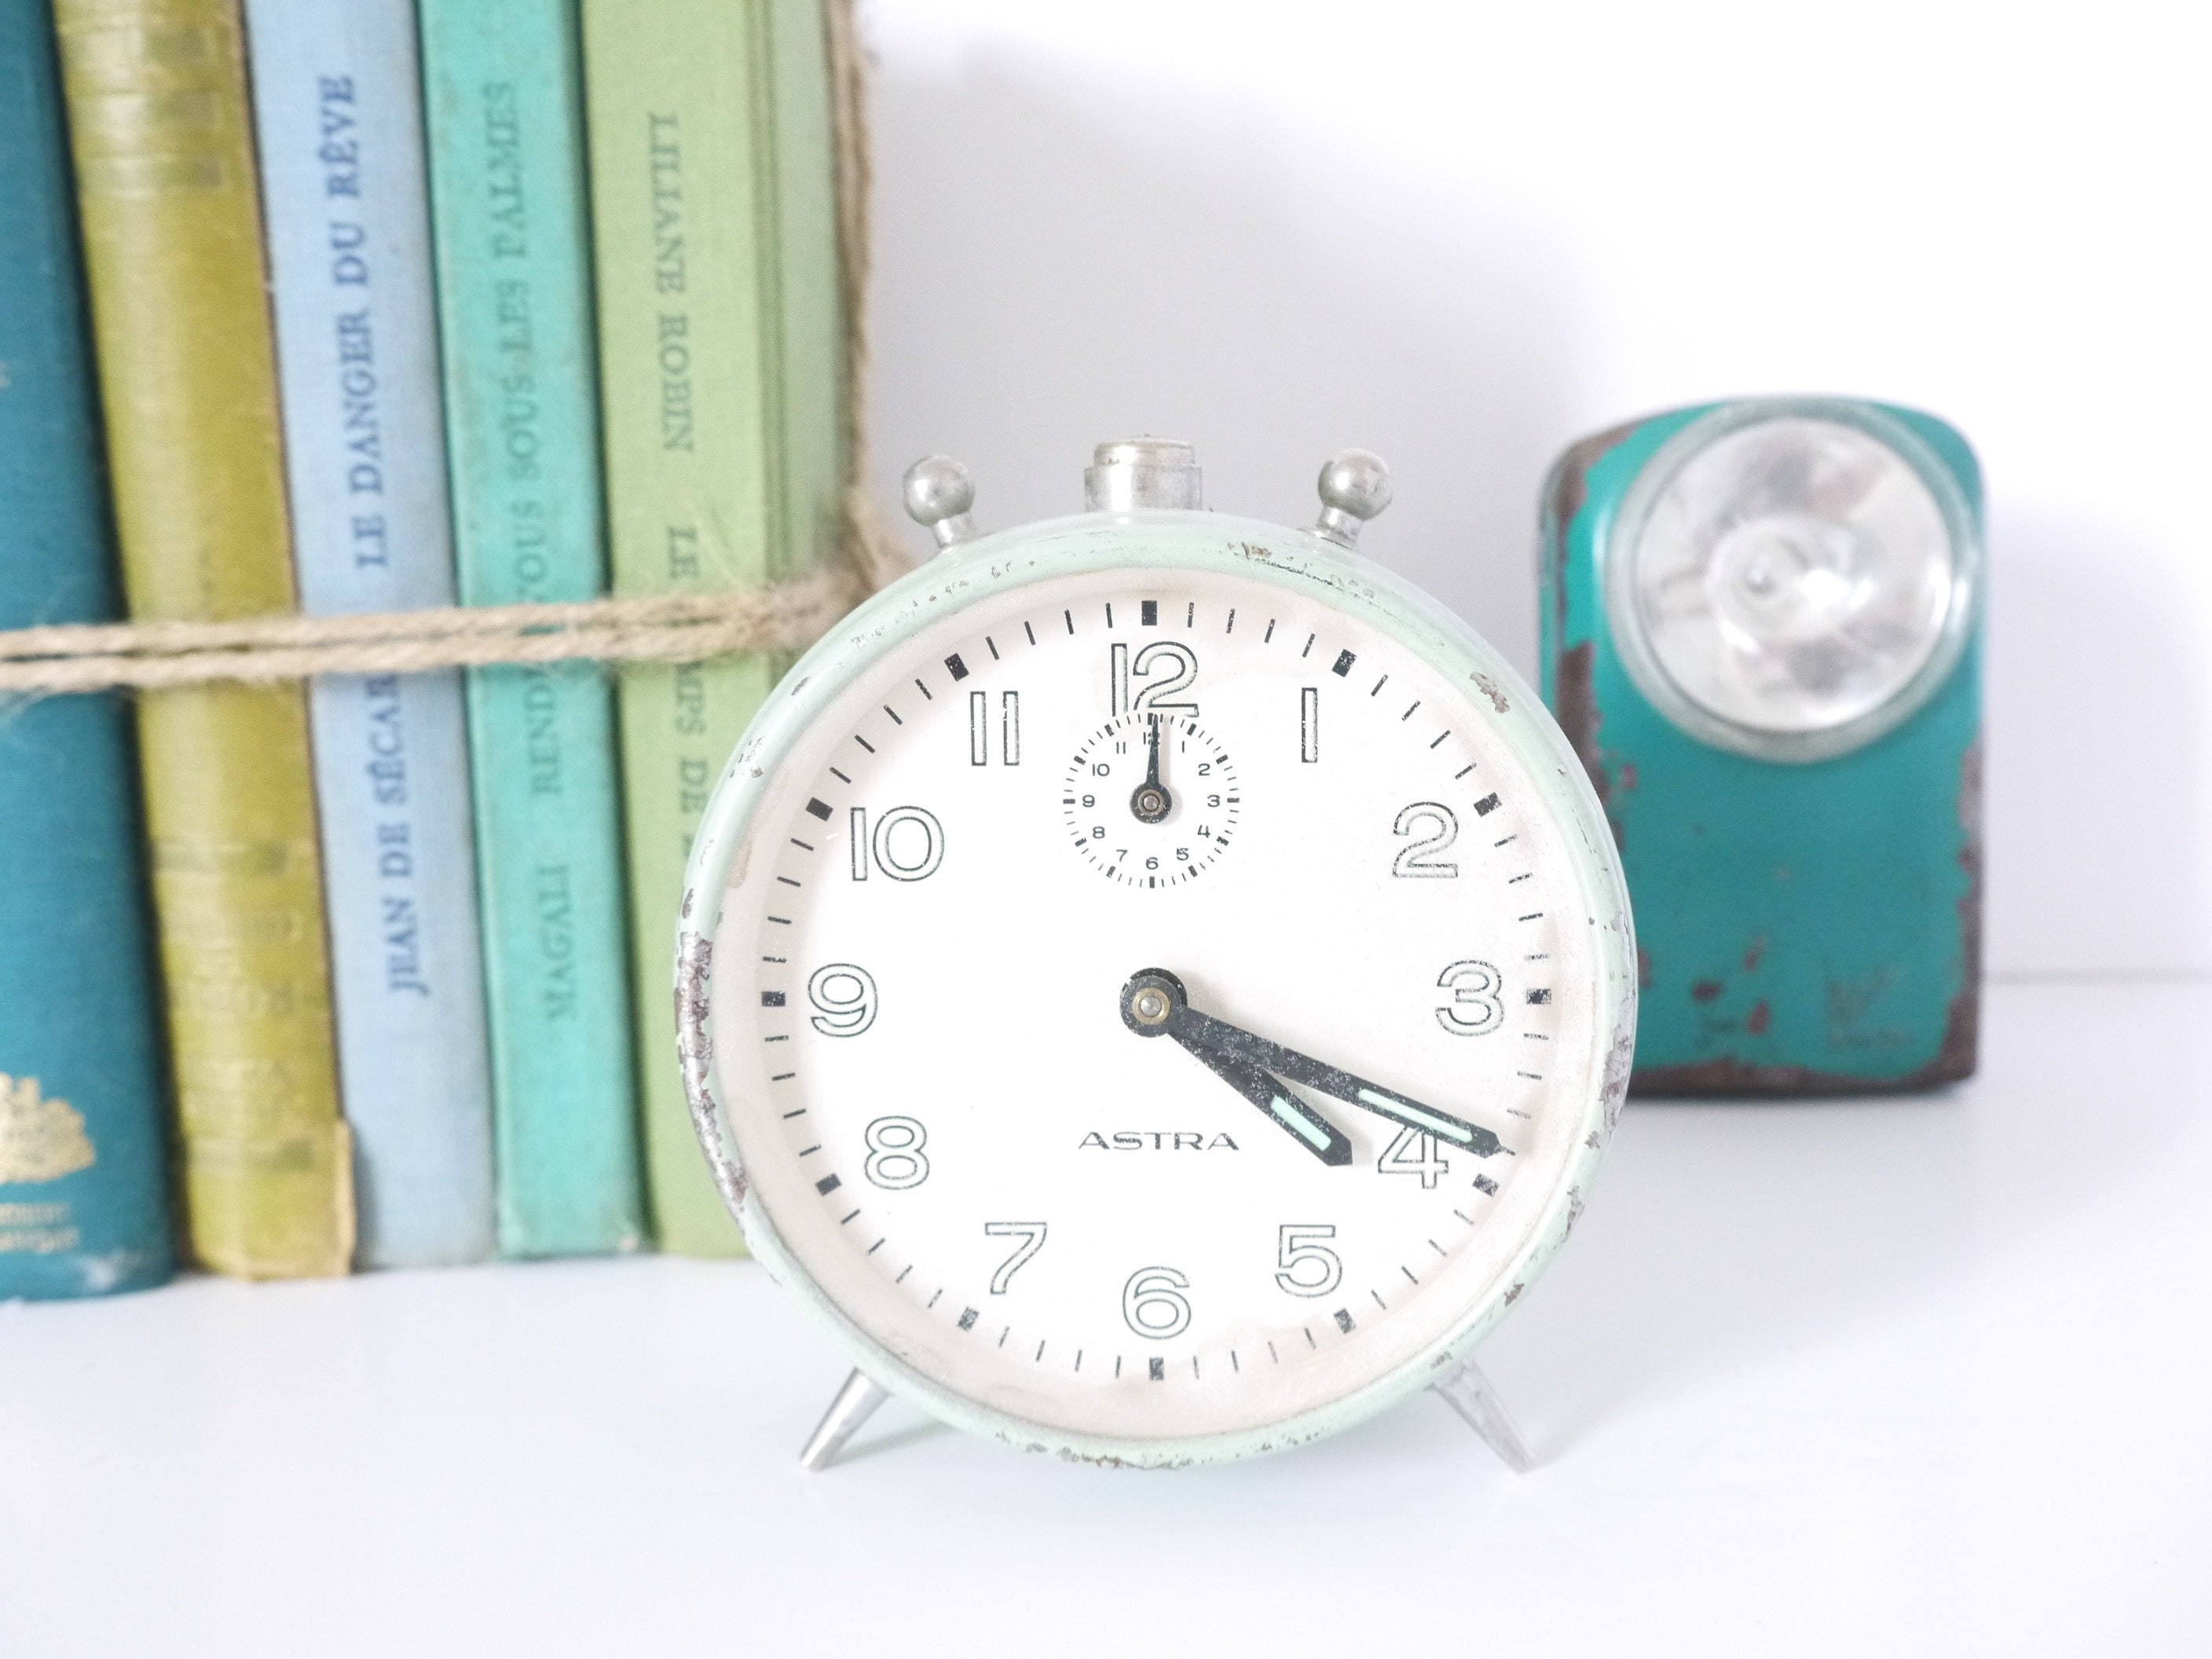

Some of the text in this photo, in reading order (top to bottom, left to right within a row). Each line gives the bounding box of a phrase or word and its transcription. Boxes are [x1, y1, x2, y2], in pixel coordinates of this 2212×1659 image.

[478, 79, 528, 262] PALMES
[647, 112, 687, 296] LILIANE
[317, 73, 390, 571] LE DANGER DU RÊVE
[496, 280, 535, 356] LES
[655, 311, 694, 455] ROBIN
[498, 368, 542, 482] SOUS
[666, 524, 699, 580] LE
[1111, 639, 1199, 718] 12
[970, 691, 1020, 766] 11
[1116, 742, 1126, 754] 11
[1302, 687, 1318, 763] 1
[679, 756, 710, 815] DE
[1082, 795, 1095, 808] 9
[1093, 764, 1110, 776] 10
[1199, 764, 1210, 776] 2
[1207, 795, 1221, 808] 3
[364, 674, 430, 998] JEAN DE SÉCAR
[851, 806, 944, 881] 10
[1093, 826, 1105, 839] 8
[1116, 849, 1128, 862] 7
[1145, 857, 1159, 870] 6
[1177, 848, 1189, 861] 5
[1197, 825, 1210, 838] 4
[1393, 802, 1458, 877] 2
[534, 863, 578, 1023] MAGALI
[808, 963, 877, 1038] 9
[1434, 960, 1504, 1036] 3
[864, 1116, 929, 1189] 8
[1079, 1132, 1239, 1151] ASTRA
[1378, 1125, 1448, 1189] 4
[984, 1221, 1047, 1295] 7
[1275, 1225, 1342, 1297] 5
[1122, 1266, 1191, 1339] 6
